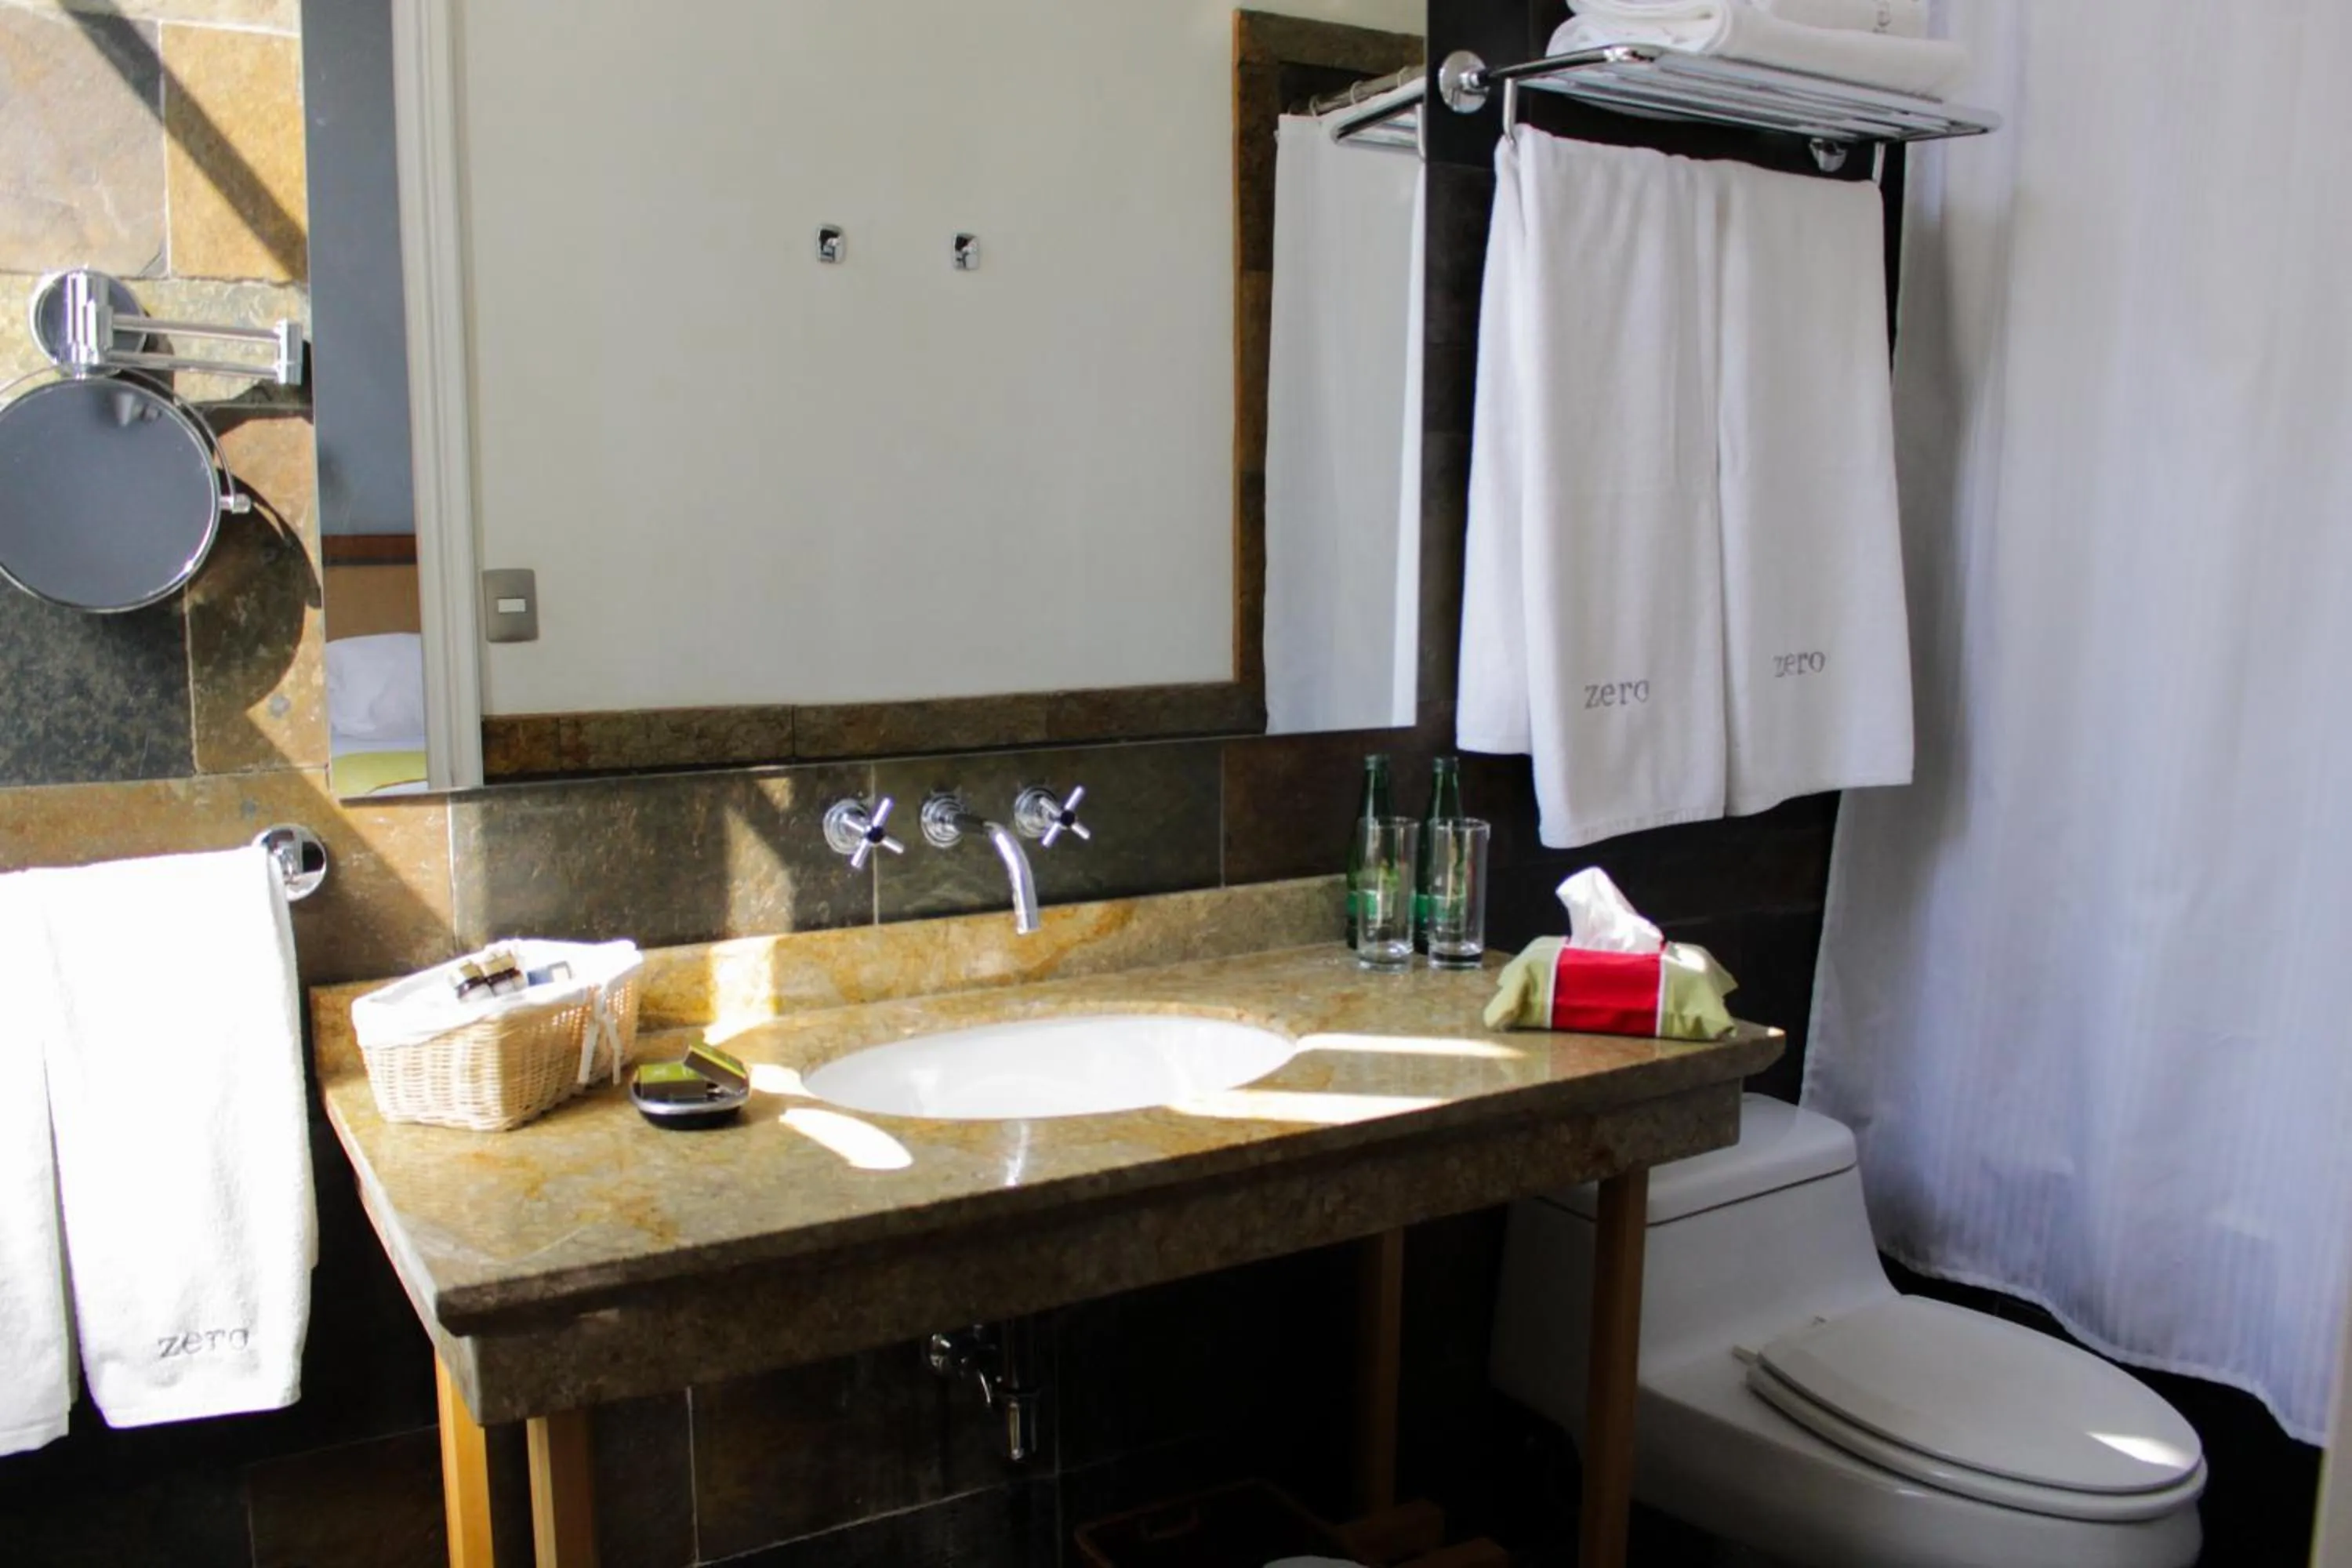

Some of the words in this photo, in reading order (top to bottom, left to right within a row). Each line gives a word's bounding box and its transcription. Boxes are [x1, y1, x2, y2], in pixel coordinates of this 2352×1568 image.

[1772, 651, 1826, 678] zero
[1583, 679, 1650, 710] zero
[157, 1328, 249, 1359] zero
